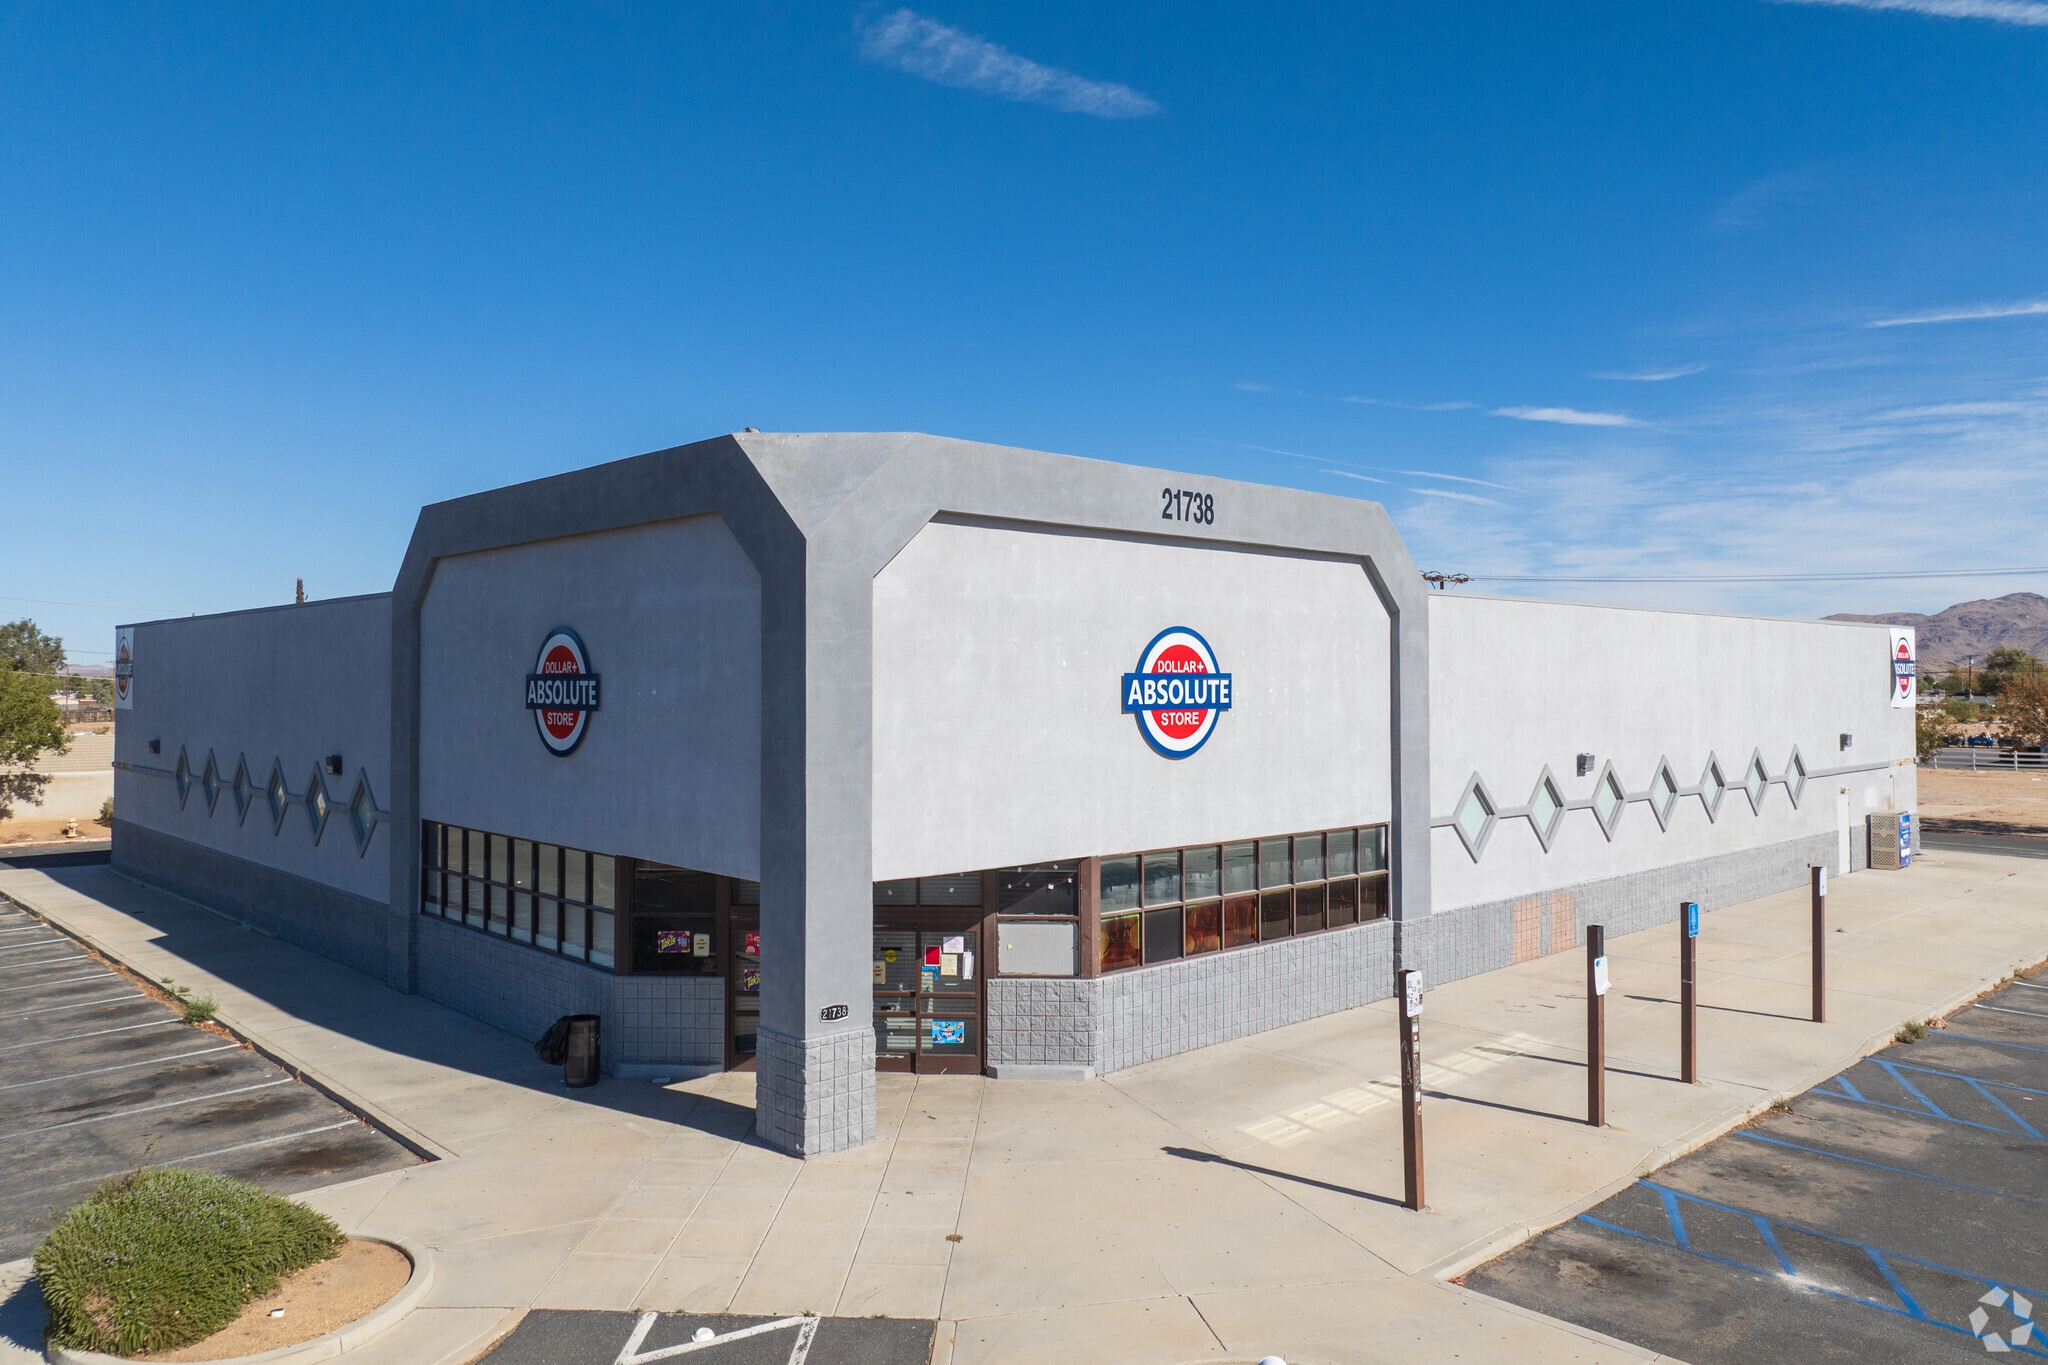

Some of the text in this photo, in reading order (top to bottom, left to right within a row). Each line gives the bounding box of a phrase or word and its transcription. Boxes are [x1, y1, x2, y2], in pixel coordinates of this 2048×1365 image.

[1161, 487, 1215, 526] 21738
[528, 680, 596, 705] ABSOLUTE
[1127, 679, 1230, 706] ABSOLUTE
[547, 712, 574, 726] STORE
[1161, 711, 1200, 726] STORE
[822, 1006, 847, 1020] 21738
